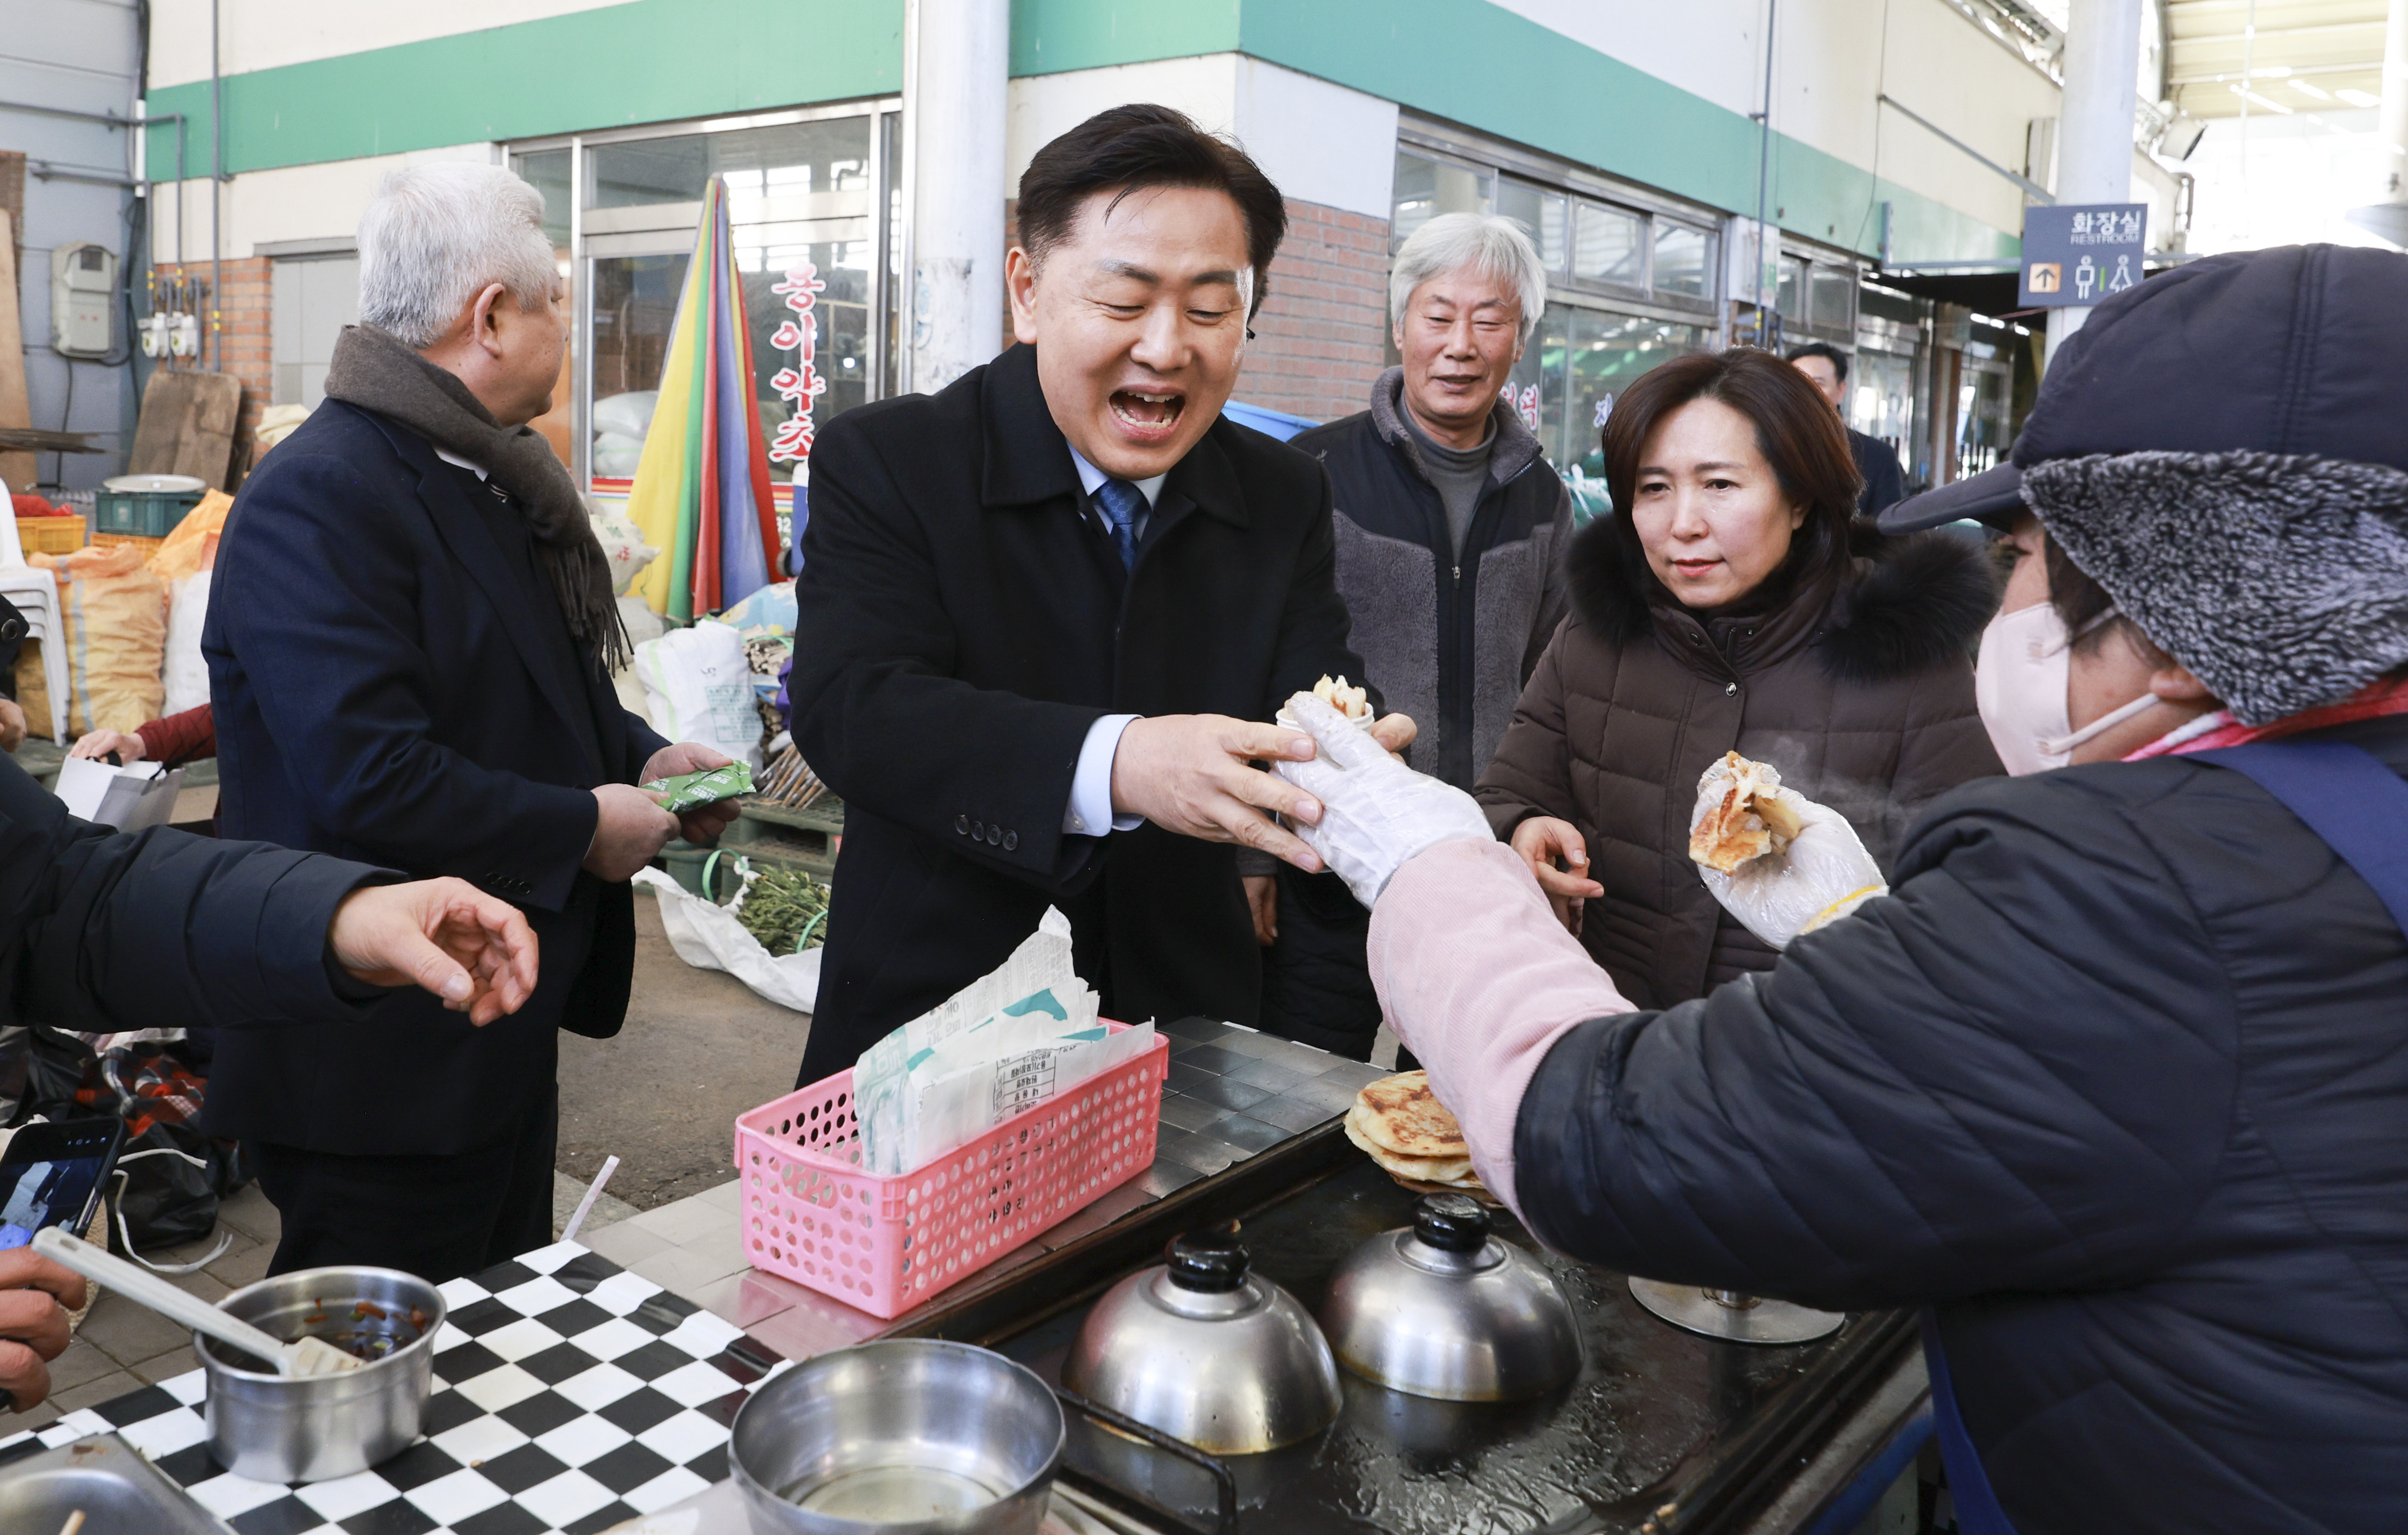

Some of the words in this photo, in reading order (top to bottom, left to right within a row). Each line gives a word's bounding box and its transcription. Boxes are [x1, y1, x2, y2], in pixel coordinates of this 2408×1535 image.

[2071, 211, 2141, 236] 화장실
[2070, 234, 2139, 246] RESTROOM
[1017, 1075, 1037, 1088] 원재료명
